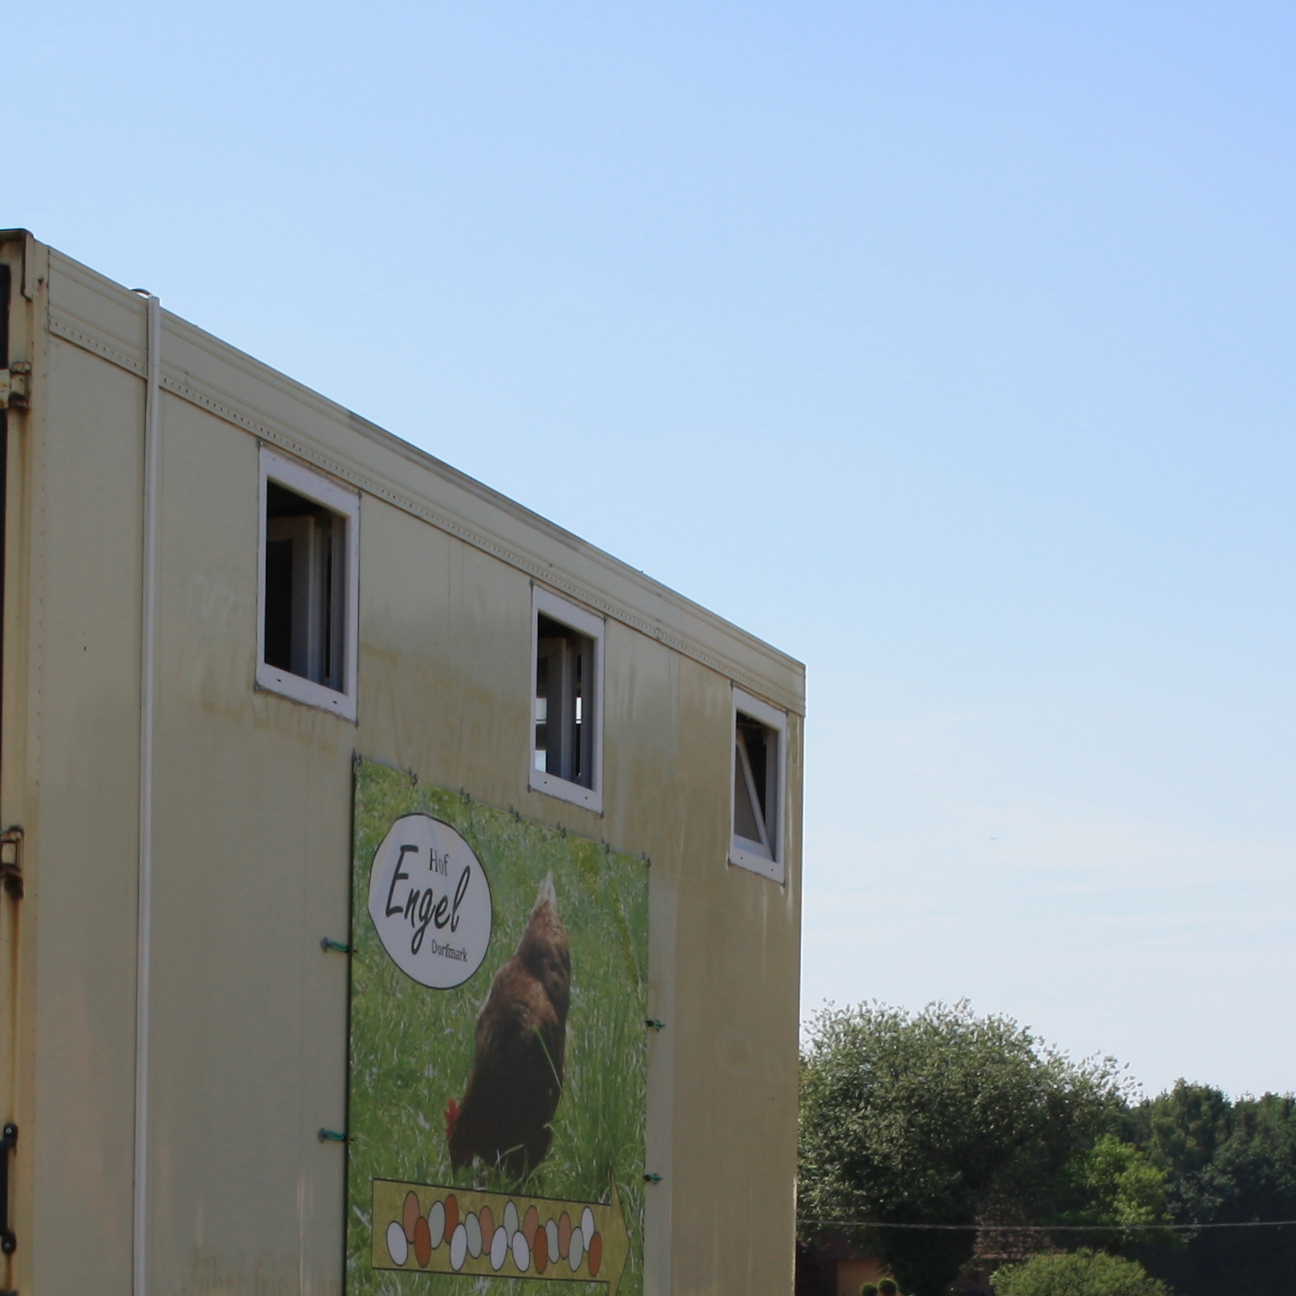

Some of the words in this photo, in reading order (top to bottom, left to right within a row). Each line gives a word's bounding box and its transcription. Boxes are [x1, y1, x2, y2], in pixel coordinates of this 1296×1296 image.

[428, 847, 450, 877] Hof
[385, 844, 471, 955] Engel
[431, 939, 469, 963] Dorfmark
